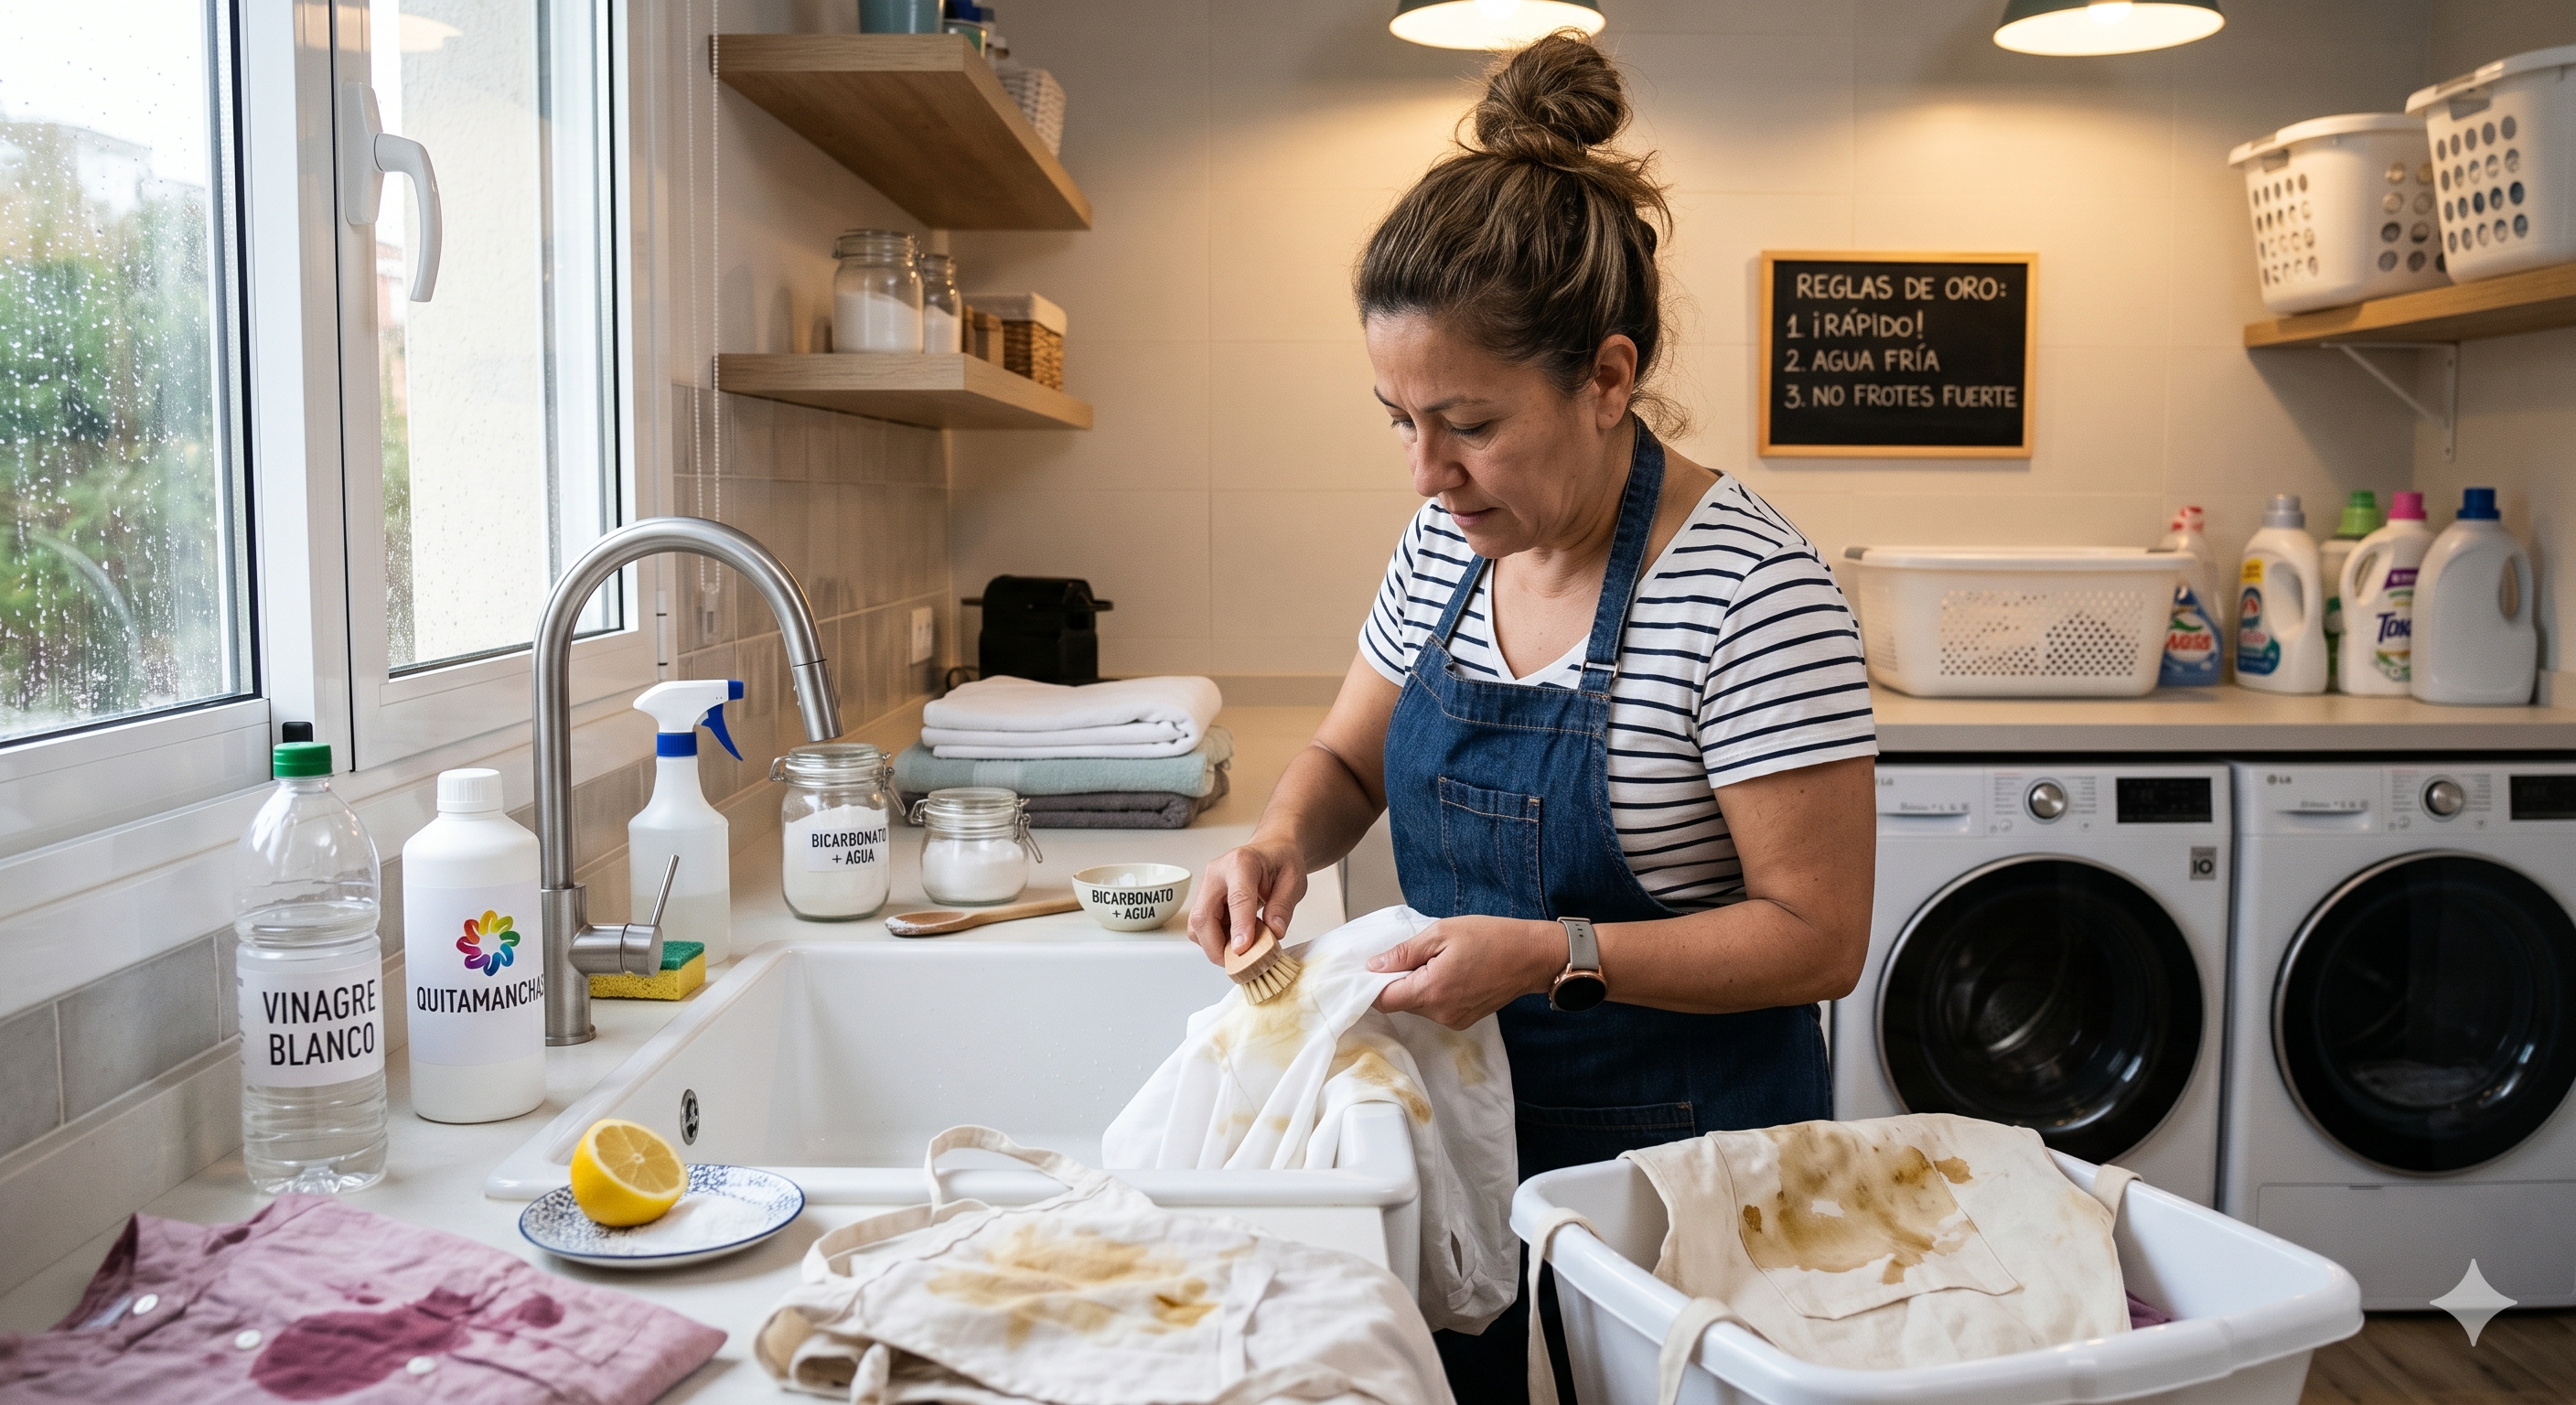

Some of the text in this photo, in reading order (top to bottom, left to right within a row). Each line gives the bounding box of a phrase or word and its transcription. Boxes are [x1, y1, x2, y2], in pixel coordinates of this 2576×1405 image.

[1797, 273, 2007, 301] REGLAS DE ORO:
[1813, 307, 1924, 339] ¡RÁPIDO!
[1784, 343, 1940, 372] 2. AGUA FRÍA
[1784, 384, 2018, 409] 3. NO FROTES FUERTE
[811, 828, 886, 848] BICARBONATO
[832, 849, 875, 864] + AGUA
[1091, 888, 1174, 906] BICARBONATO
[1111, 906, 1155, 919] + AGUA
[263, 979, 376, 1024] VINAGRE
[270, 1022, 375, 1066] BLANCO
